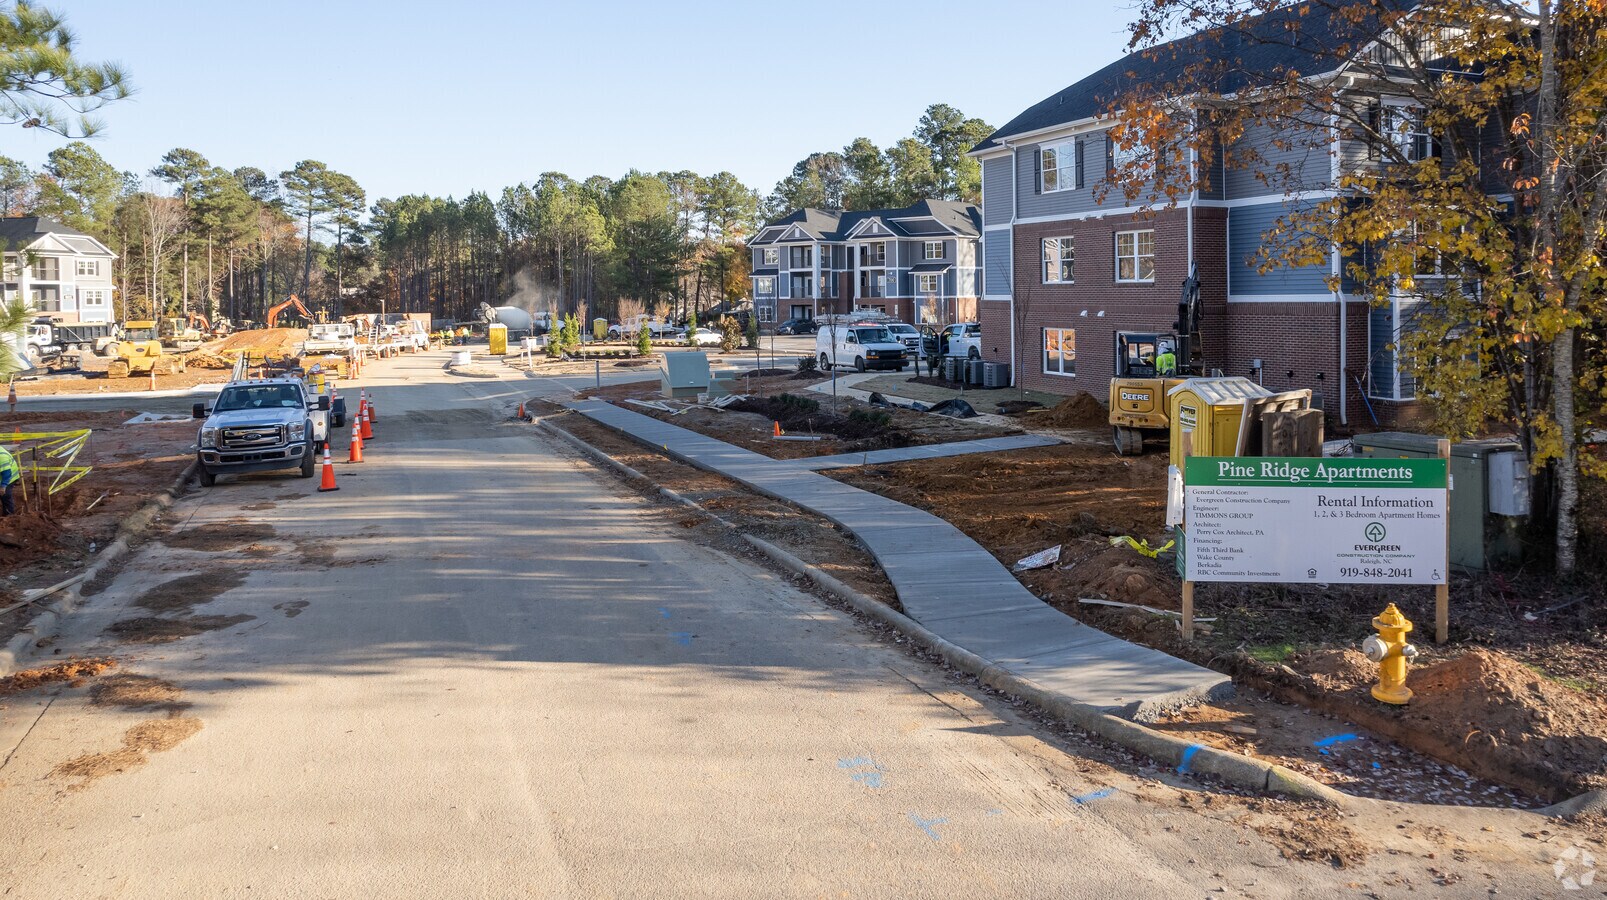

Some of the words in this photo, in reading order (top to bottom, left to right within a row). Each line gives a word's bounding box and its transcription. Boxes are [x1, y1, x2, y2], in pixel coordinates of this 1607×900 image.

[1122, 392, 1149, 400] DEERE
[1218, 462, 1255, 477] Pine
[1261, 462, 1309, 482] Ridge
[1314, 463, 1413, 482] Apartments
[1318, 495, 1357, 507] Rental
[1361, 496, 1434, 508] Information
[1354, 545, 1401, 553] EVERGREEN
[1340, 568, 1413, 578] 919-848-2041
